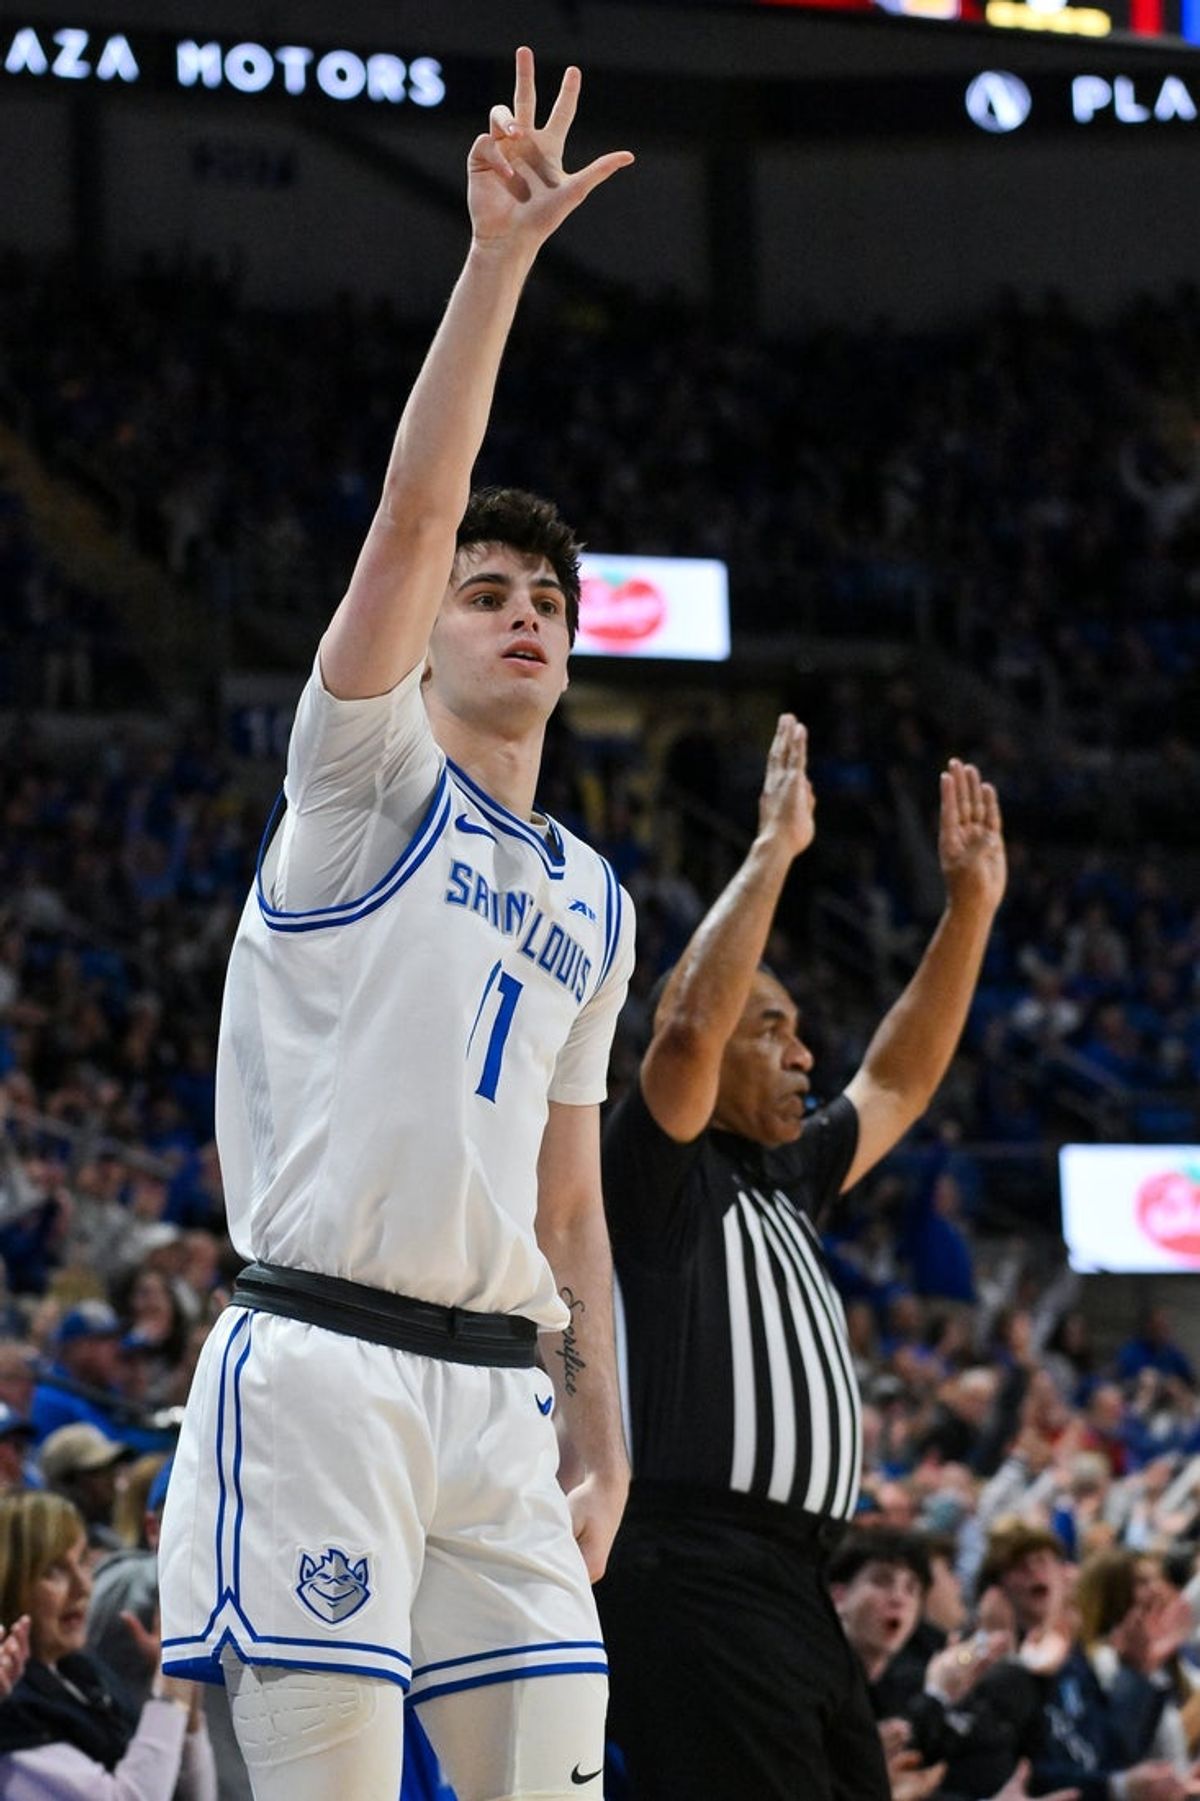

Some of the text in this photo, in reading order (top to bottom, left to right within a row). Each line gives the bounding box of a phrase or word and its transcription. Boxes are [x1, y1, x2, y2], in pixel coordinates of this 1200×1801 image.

[4, 27, 446, 107] AZA MOTORS
[1071, 74, 1198, 123] PLA
[444, 859, 592, 1005] SAIN LOUIS
[466, 959, 524, 1104] 1
[555, 1286, 587, 1398] Scrifice
